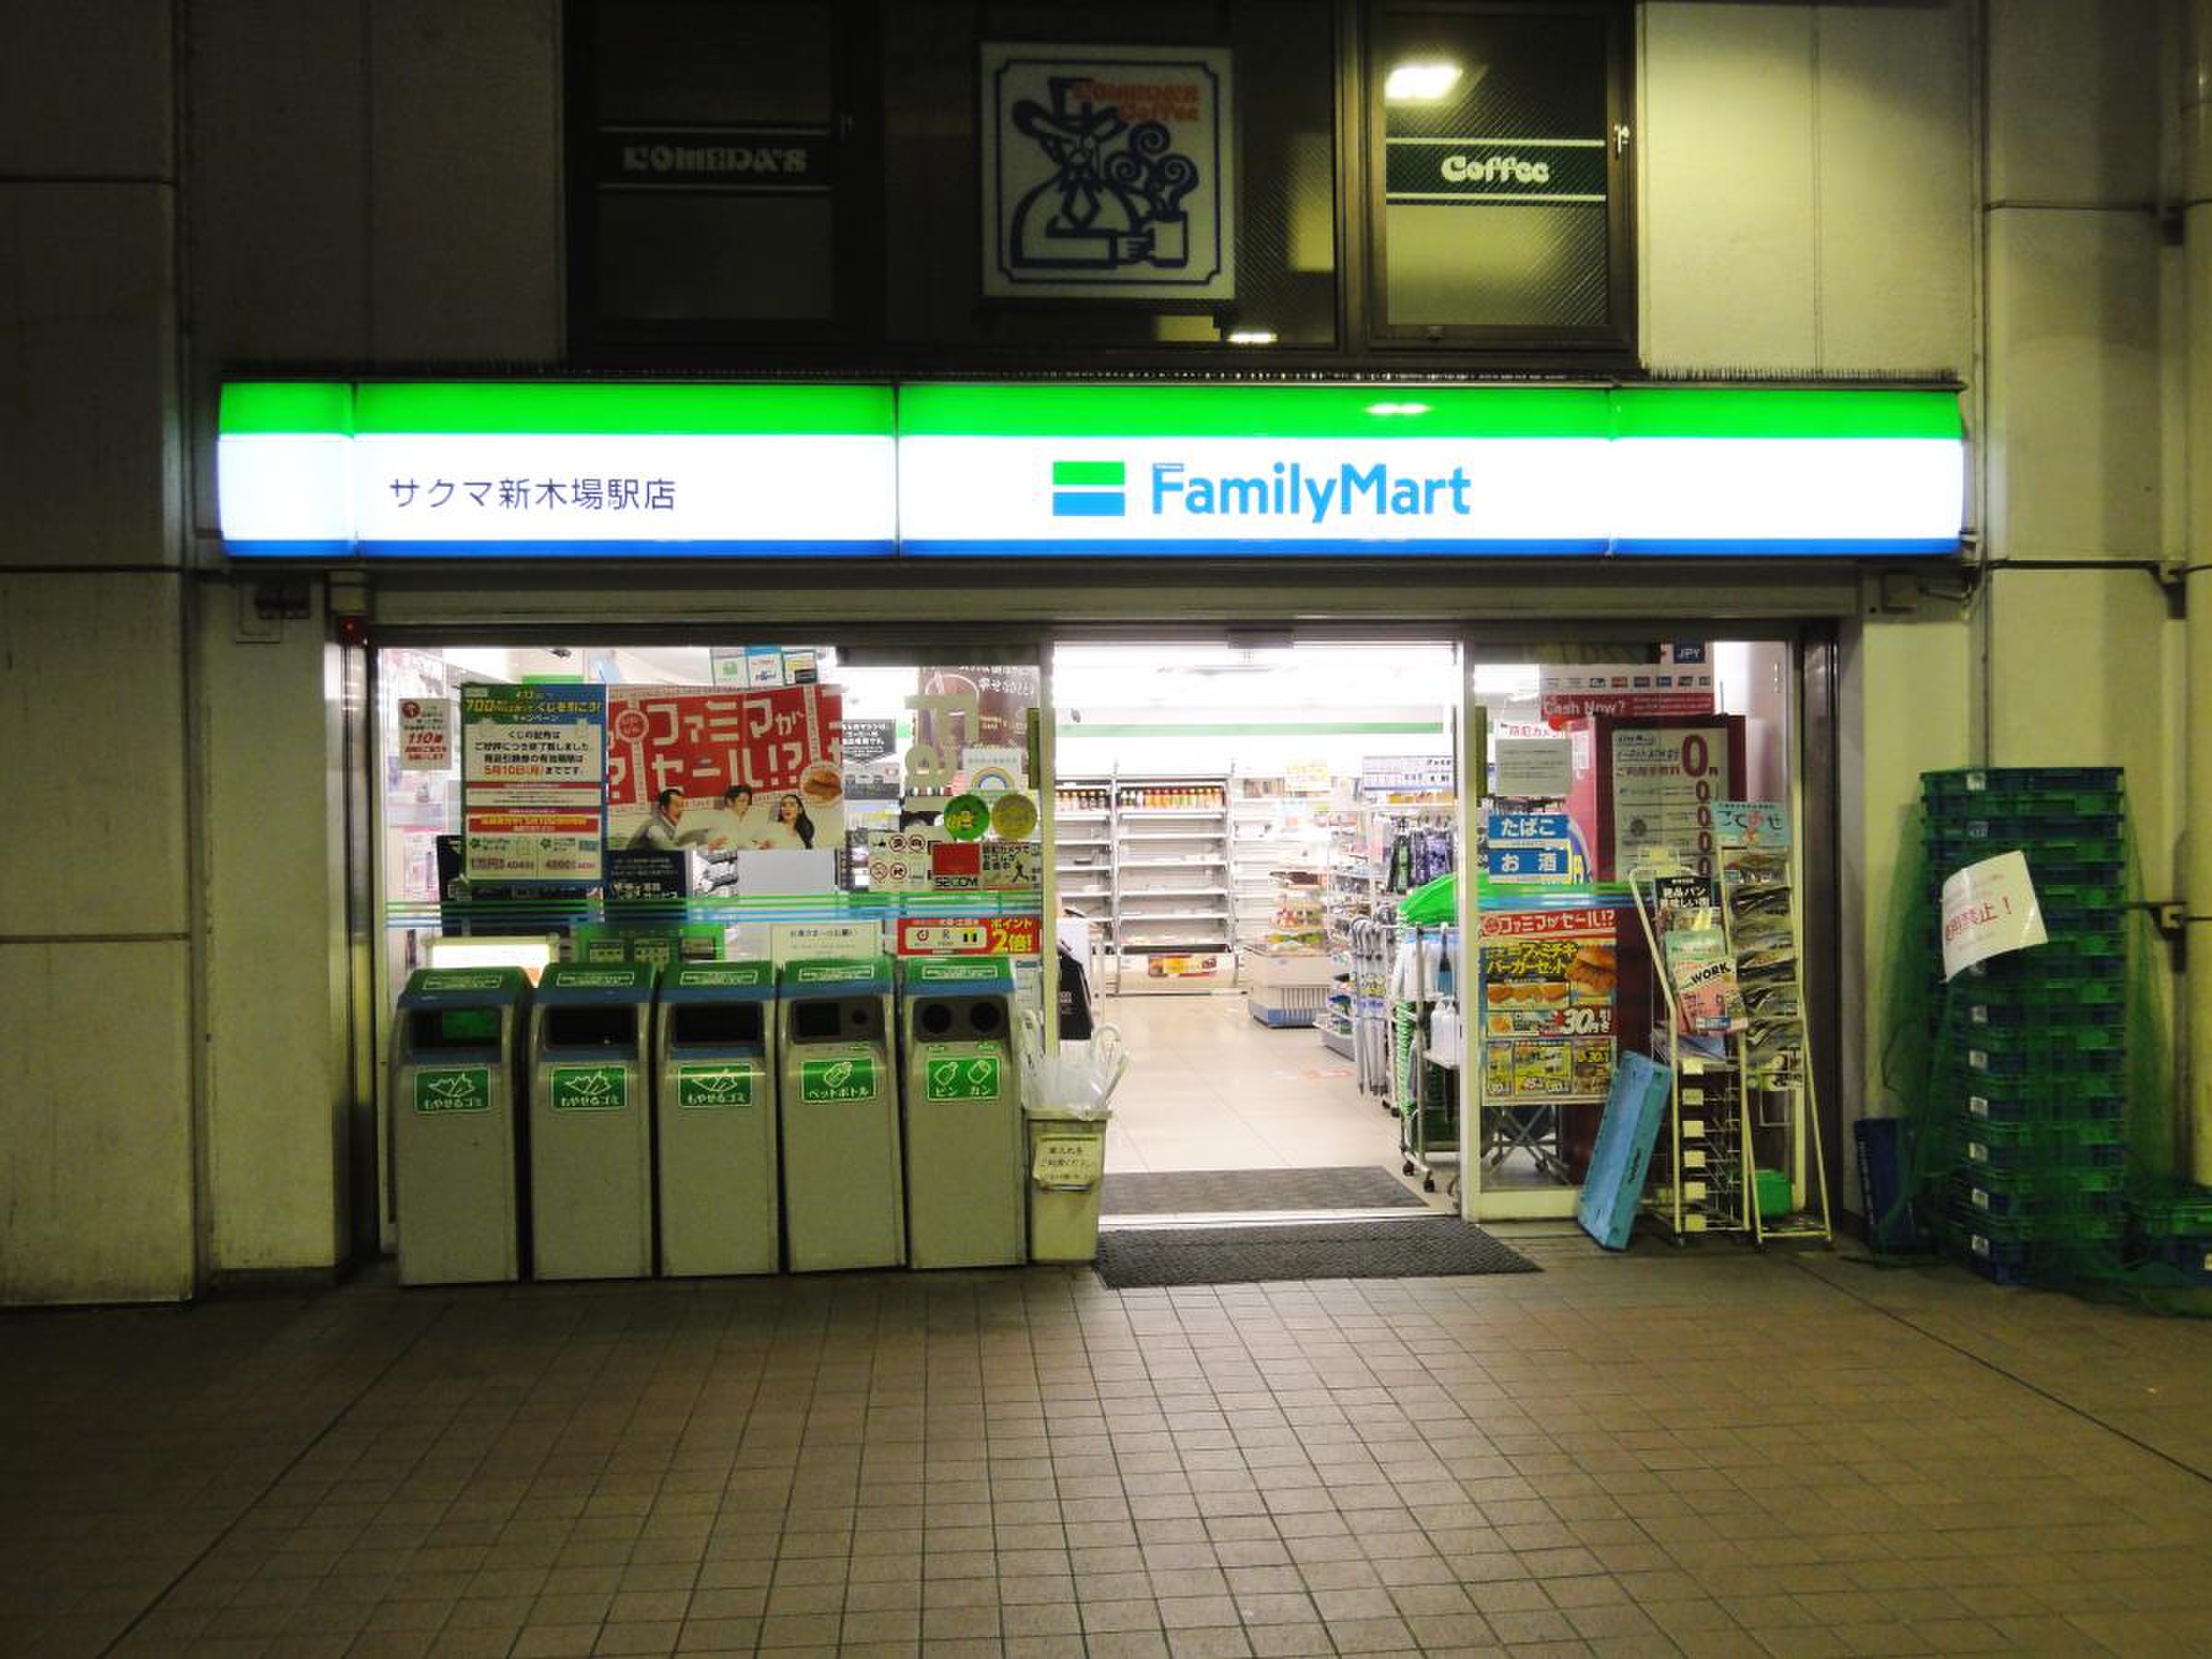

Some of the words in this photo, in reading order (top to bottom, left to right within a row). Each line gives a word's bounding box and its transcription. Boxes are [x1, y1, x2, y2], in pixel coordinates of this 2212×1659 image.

[1441, 155, 1549, 182] Coffee
[389, 477, 677, 510] サクマ新木場駅店
[1151, 462, 1472, 524] FamilyMart
[1677, 648, 1701, 660] JPY
[1500, 819, 1556, 837] たばこ
[934, 877, 979, 888] SECOM
[991, 919, 1032, 928] ポイント
[1690, 961, 1732, 985] WORK
[808, 1088, 869, 1099] ペットボトル
[935, 1086, 957, 1097] ビン
[970, 1085, 991, 1097] カン
